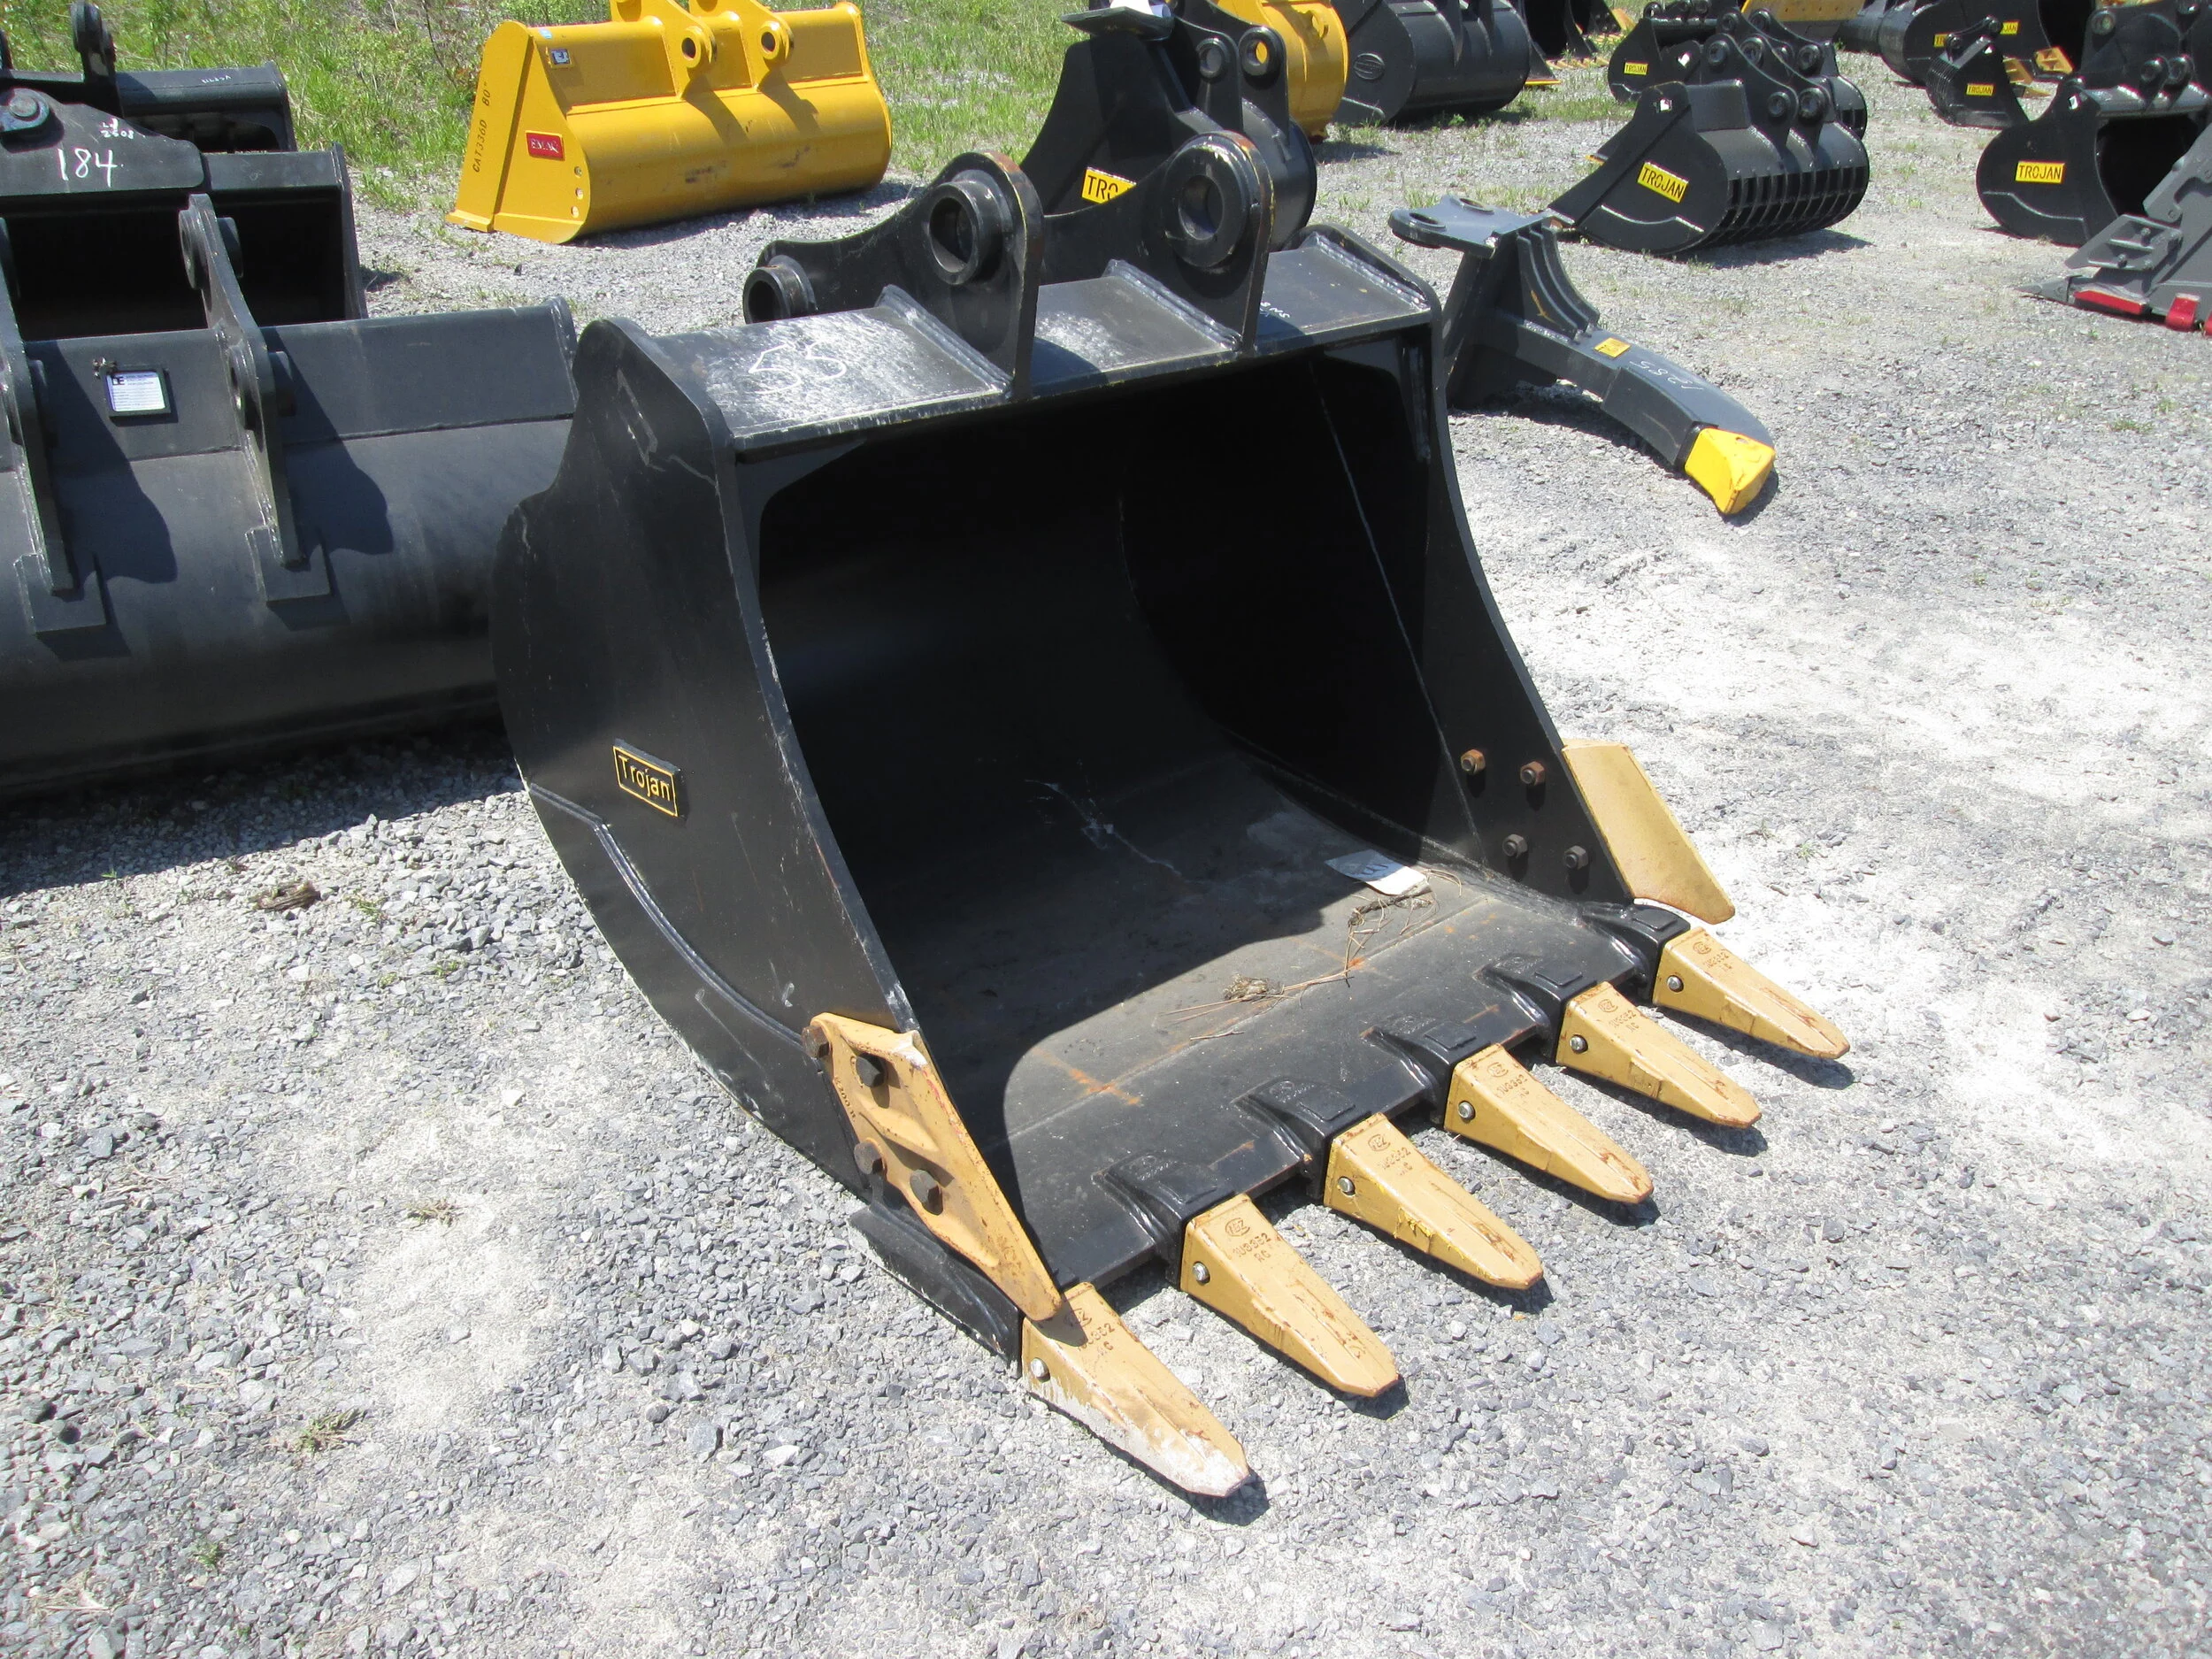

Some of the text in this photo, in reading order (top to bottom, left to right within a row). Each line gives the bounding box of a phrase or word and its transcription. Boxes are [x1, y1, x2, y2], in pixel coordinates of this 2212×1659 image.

[1968, 85, 1993, 95] TROJAN
[472, 119, 488, 173] CAT336D
[58, 147, 119, 188] 184
[1641, 167, 1685, 199] TROJAN
[2018, 165, 2062, 180] TROJAN
[1087, 174, 1119, 201] TRO
[618, 755, 671, 802] Trojan
